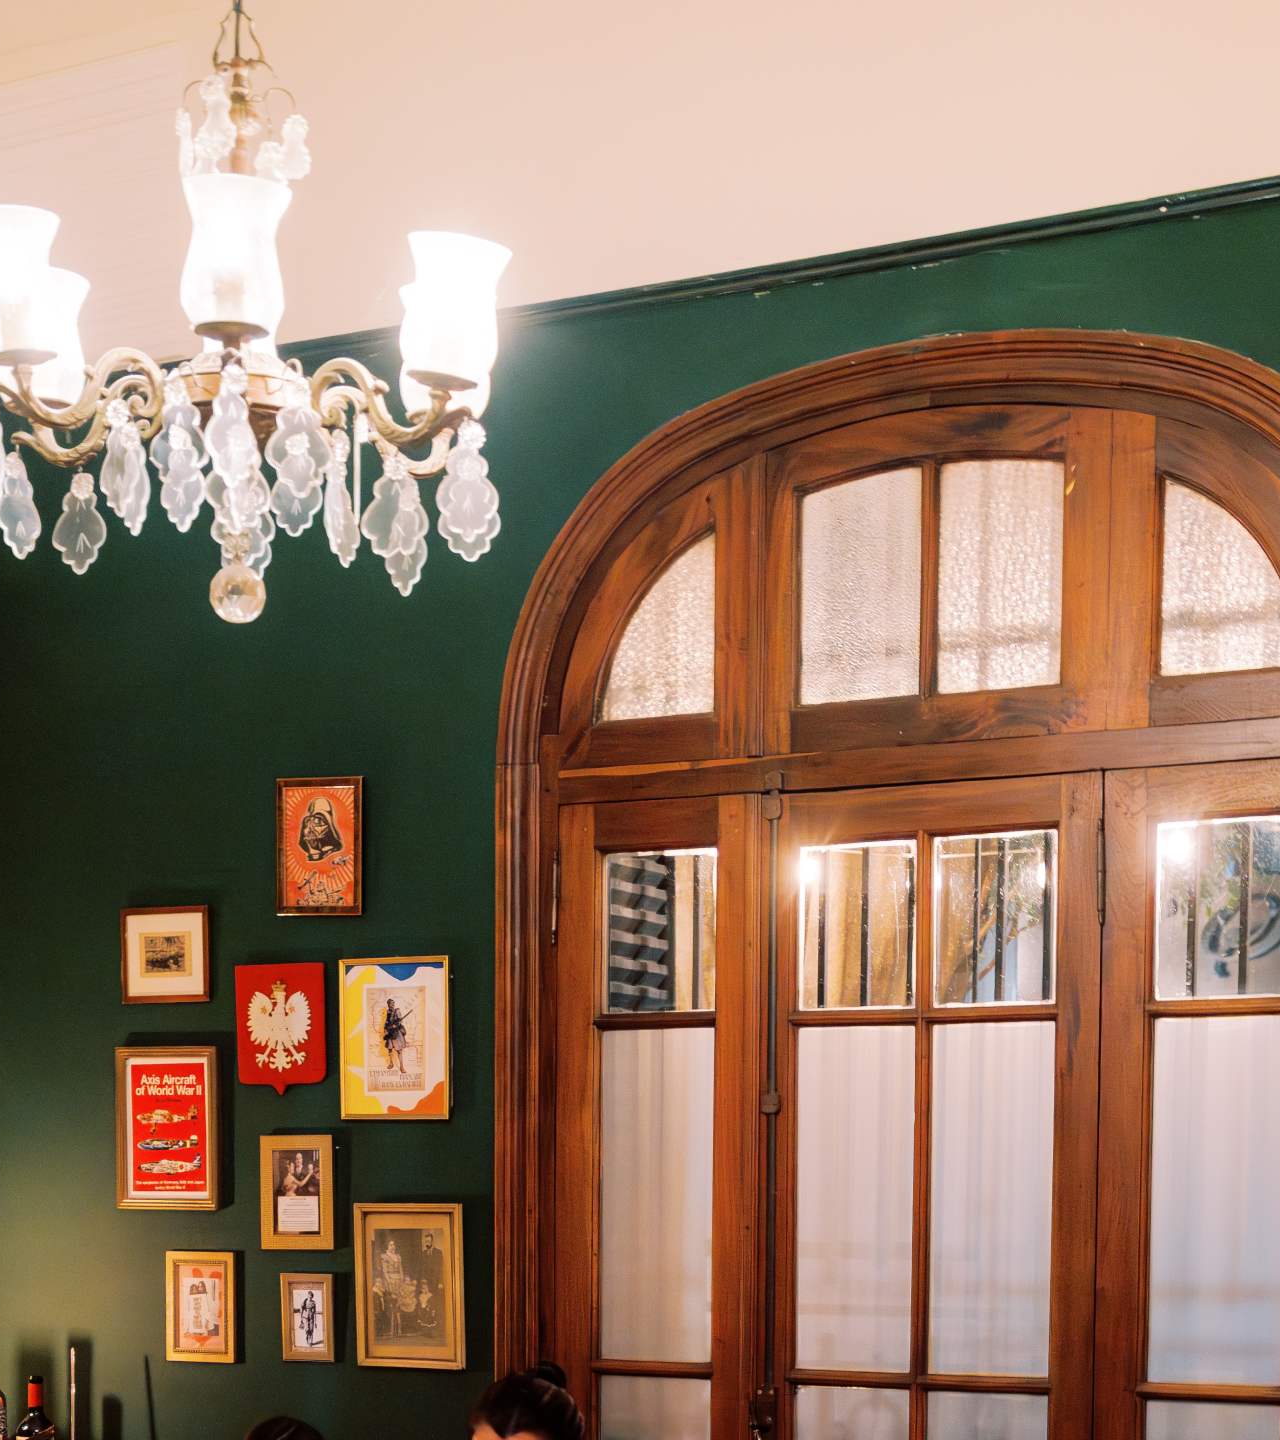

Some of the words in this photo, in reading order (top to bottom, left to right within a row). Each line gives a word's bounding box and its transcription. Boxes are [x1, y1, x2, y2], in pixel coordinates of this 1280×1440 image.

[140, 1074, 161, 1085] Axis
[162, 1074, 197, 1085] Aircraft
[135, 1085, 146, 1096] of
[146, 1085, 174, 1096] World
[176, 1085, 193, 1095] War
[195, 1085, 202, 1095] II
